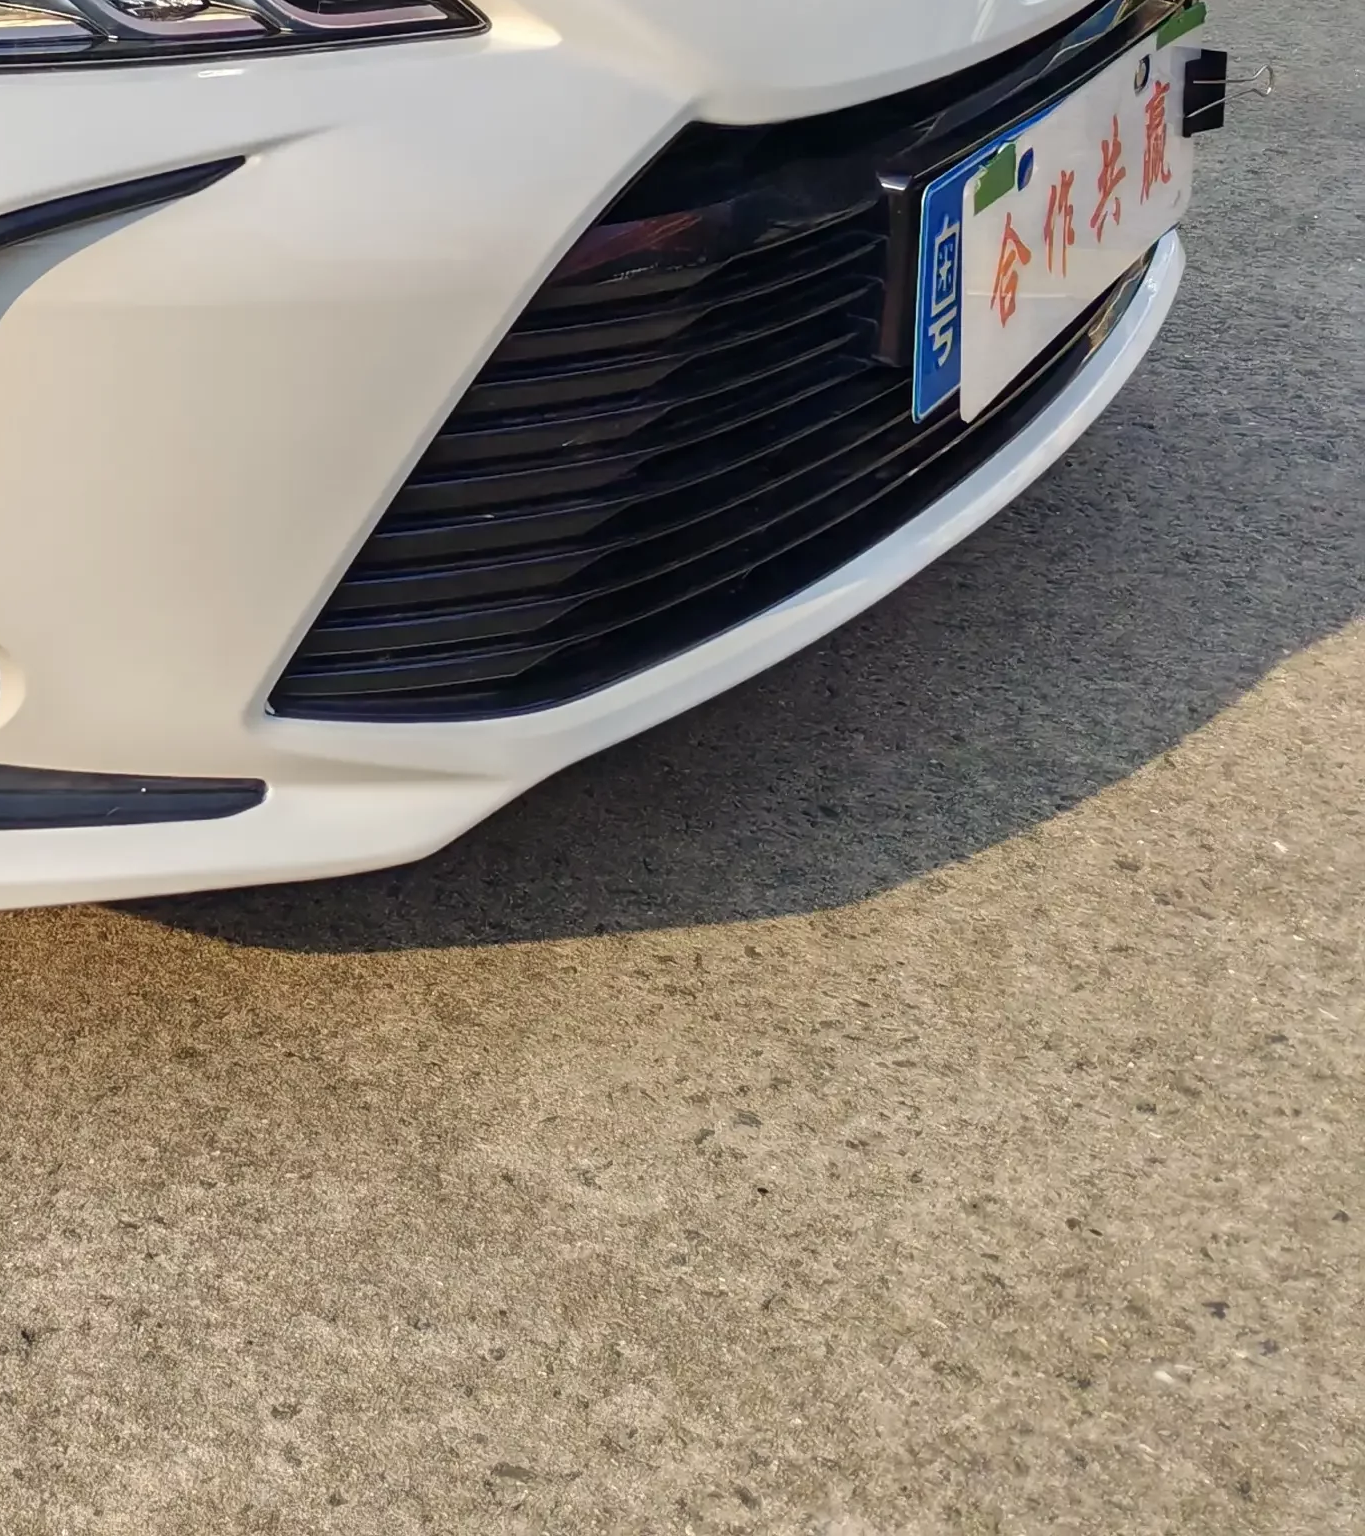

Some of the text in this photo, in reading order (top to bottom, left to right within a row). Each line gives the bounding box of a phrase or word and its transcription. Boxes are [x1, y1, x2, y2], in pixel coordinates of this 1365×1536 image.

[928, 215, 961, 366] 粤
[989, 79, 1171, 329] 合作共赢
